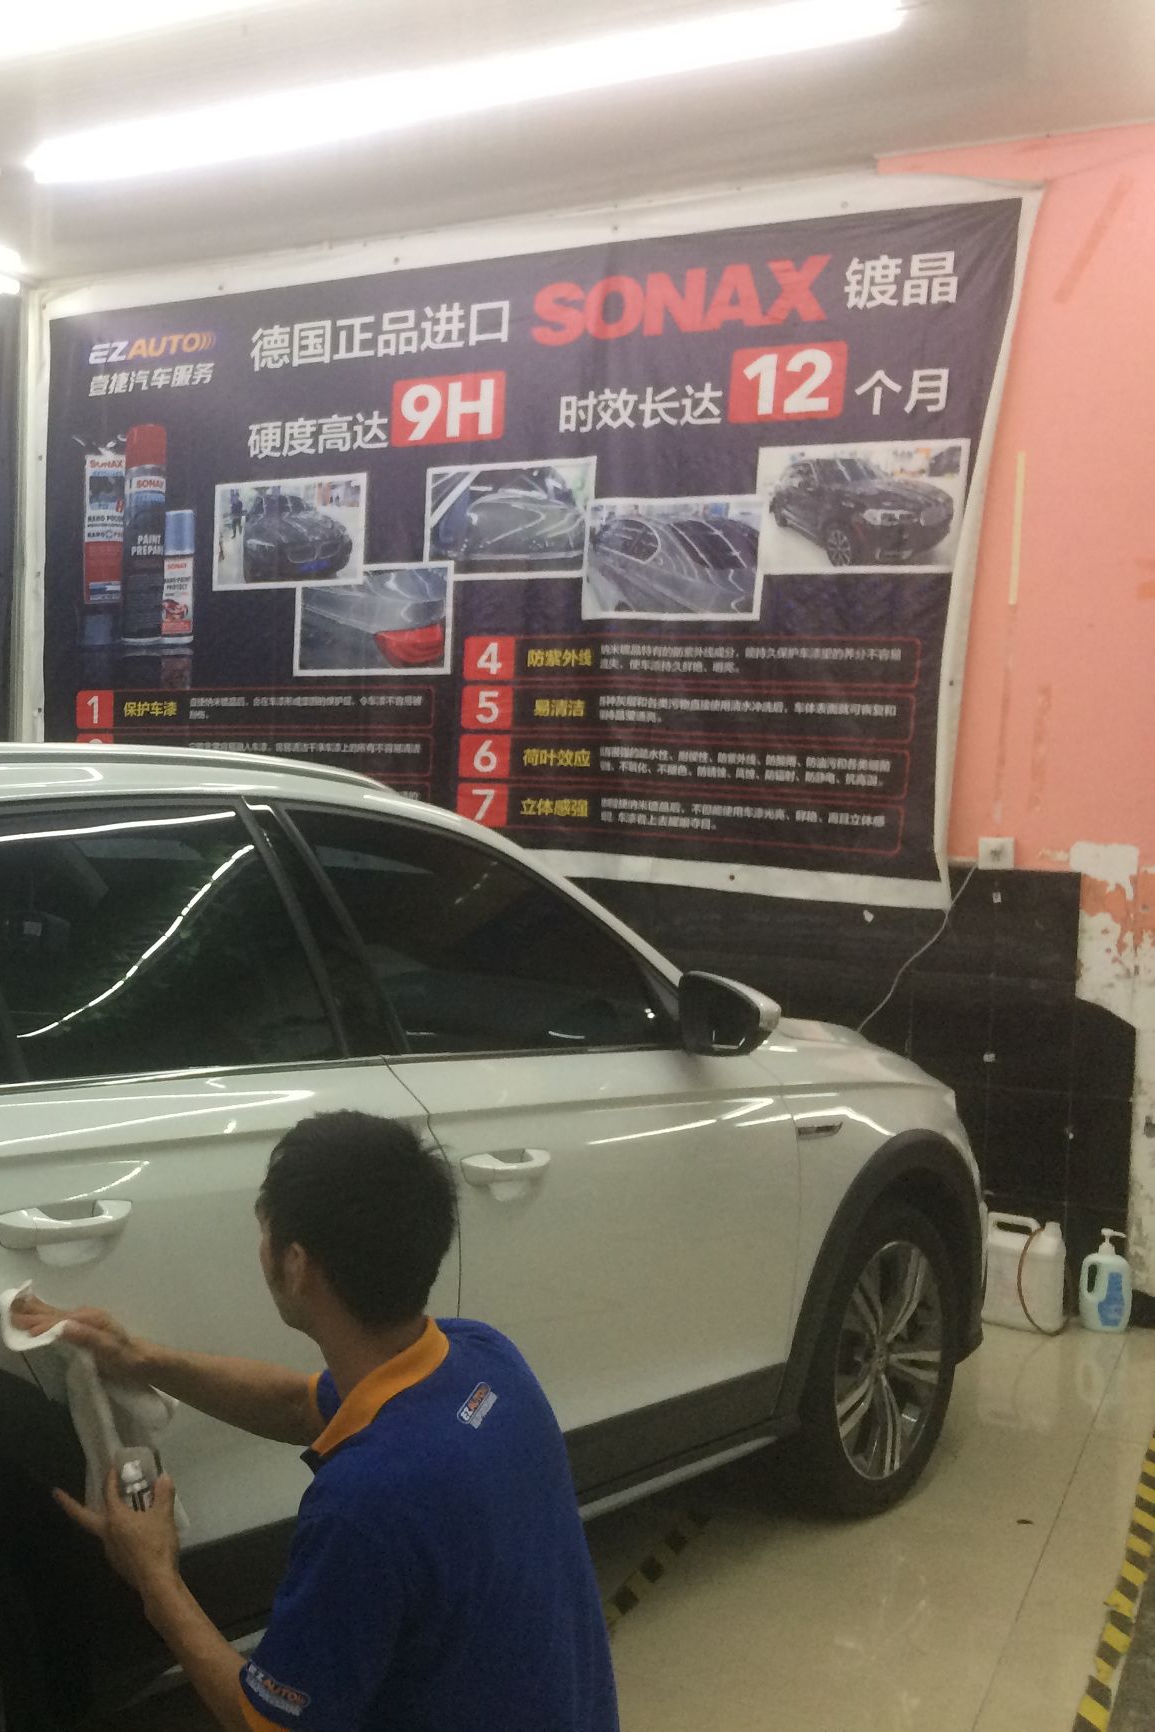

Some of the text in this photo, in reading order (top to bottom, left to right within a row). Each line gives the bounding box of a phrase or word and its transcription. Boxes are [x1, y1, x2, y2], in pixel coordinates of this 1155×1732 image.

[250, 251, 958, 372] 德国正品进口 SONAX 镀晶
[88, 332, 203, 365] EZAUTO
[247, 348, 949, 460] 硬度高达 9H 时效长达 12 个月
[477, 642, 503, 675] 4
[527, 648, 592, 668] 防紫外线
[87, 695, 99, 724] 1
[123, 701, 178, 718] 保护车漆
[476, 690, 500, 724] 5
[534, 699, 586, 718] 易清洁
[472, 739, 498, 773] 6
[522, 748, 591, 768] 荷叶效应
[470, 788, 496, 826] 7
[520, 798, 588, 818] 立体感强
